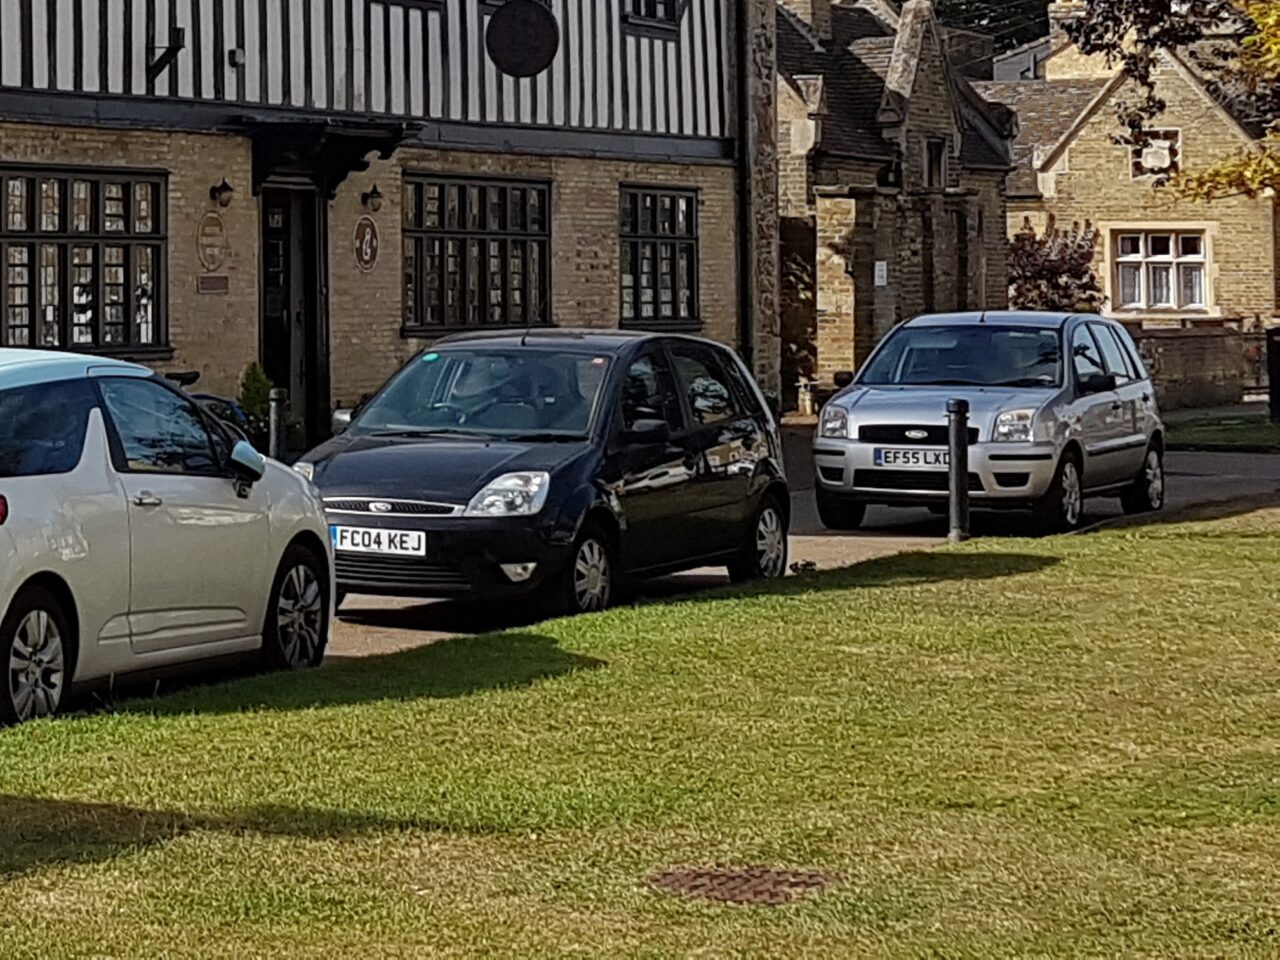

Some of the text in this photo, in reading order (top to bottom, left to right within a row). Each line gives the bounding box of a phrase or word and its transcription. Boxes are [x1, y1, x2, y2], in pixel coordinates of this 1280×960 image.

[883, 450, 920, 465] EF55
[339, 529, 422, 551] FC04 KEJ
